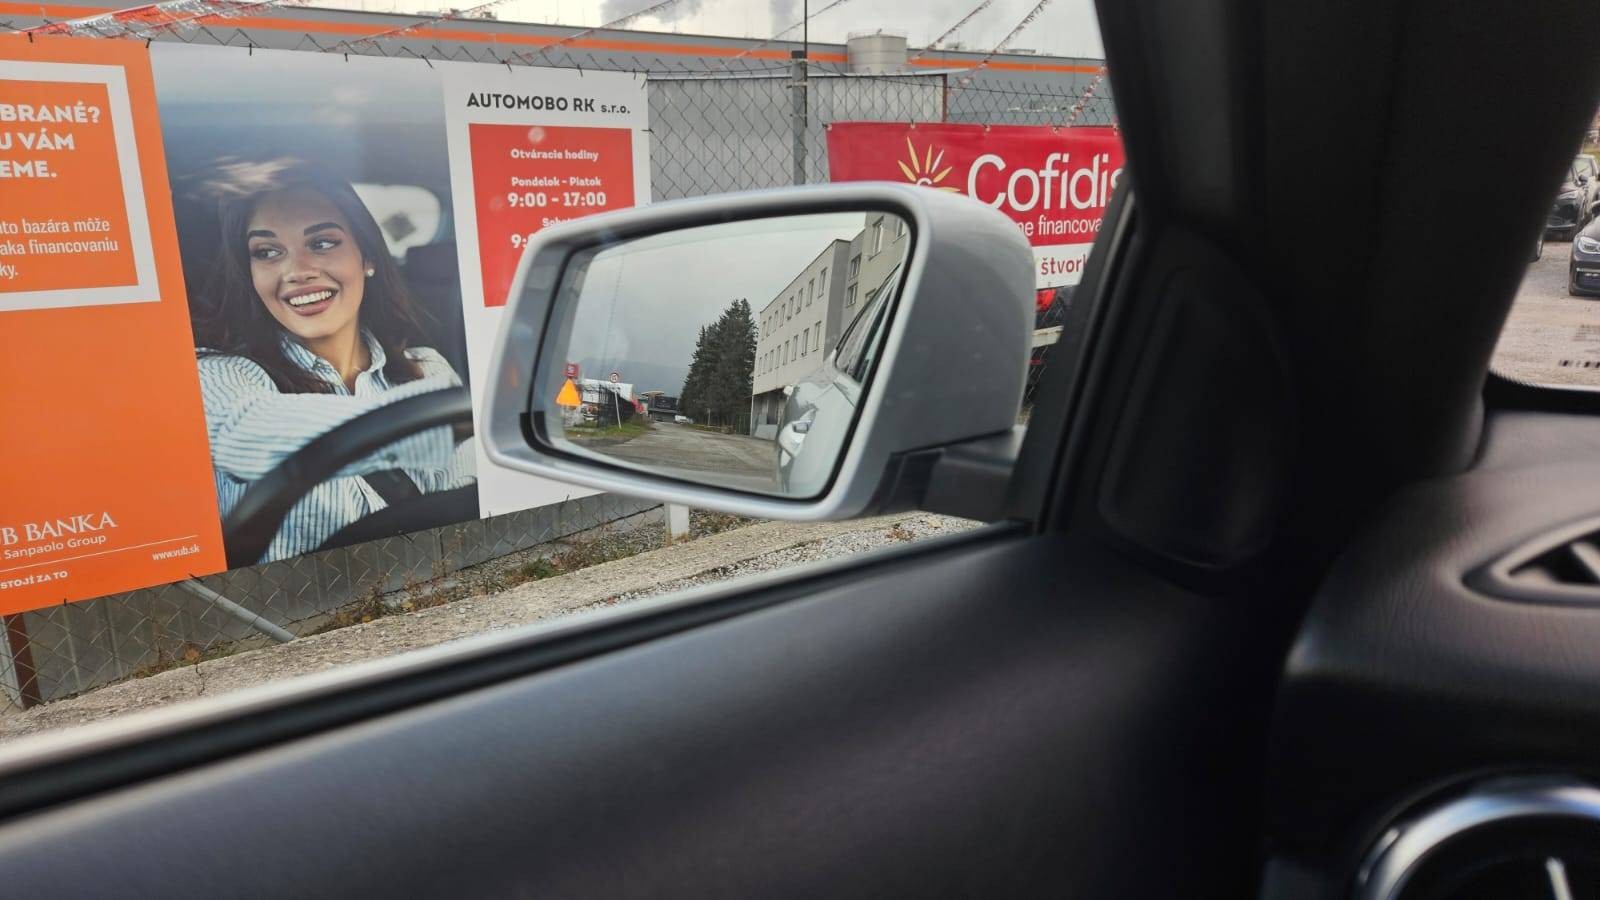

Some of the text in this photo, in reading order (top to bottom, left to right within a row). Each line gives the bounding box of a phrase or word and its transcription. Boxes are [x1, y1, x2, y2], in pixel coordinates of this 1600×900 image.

[466, 92, 631, 114] AUTOMOBO RK s.r.o.
[17, 128, 75, 150] VÁM
[511, 149, 599, 162] Otváracie hodiny
[0, 160, 57, 178] EME.
[511, 176, 560, 186] Pondelok
[569, 176, 601, 186] Piatok
[507, 192, 547, 207] 9:00
[563, 192, 607, 207] 17:00
[22, 218, 71, 234] bazára
[74, 217, 110, 232] môže
[28, 237, 118, 254] financovaniu
[24, 511, 118, 542] BANKA
[4, 535, 106, 560] Sanpaolo Group
[36, 574, 51, 583] ZA
[53, 570, 68, 580] TO
